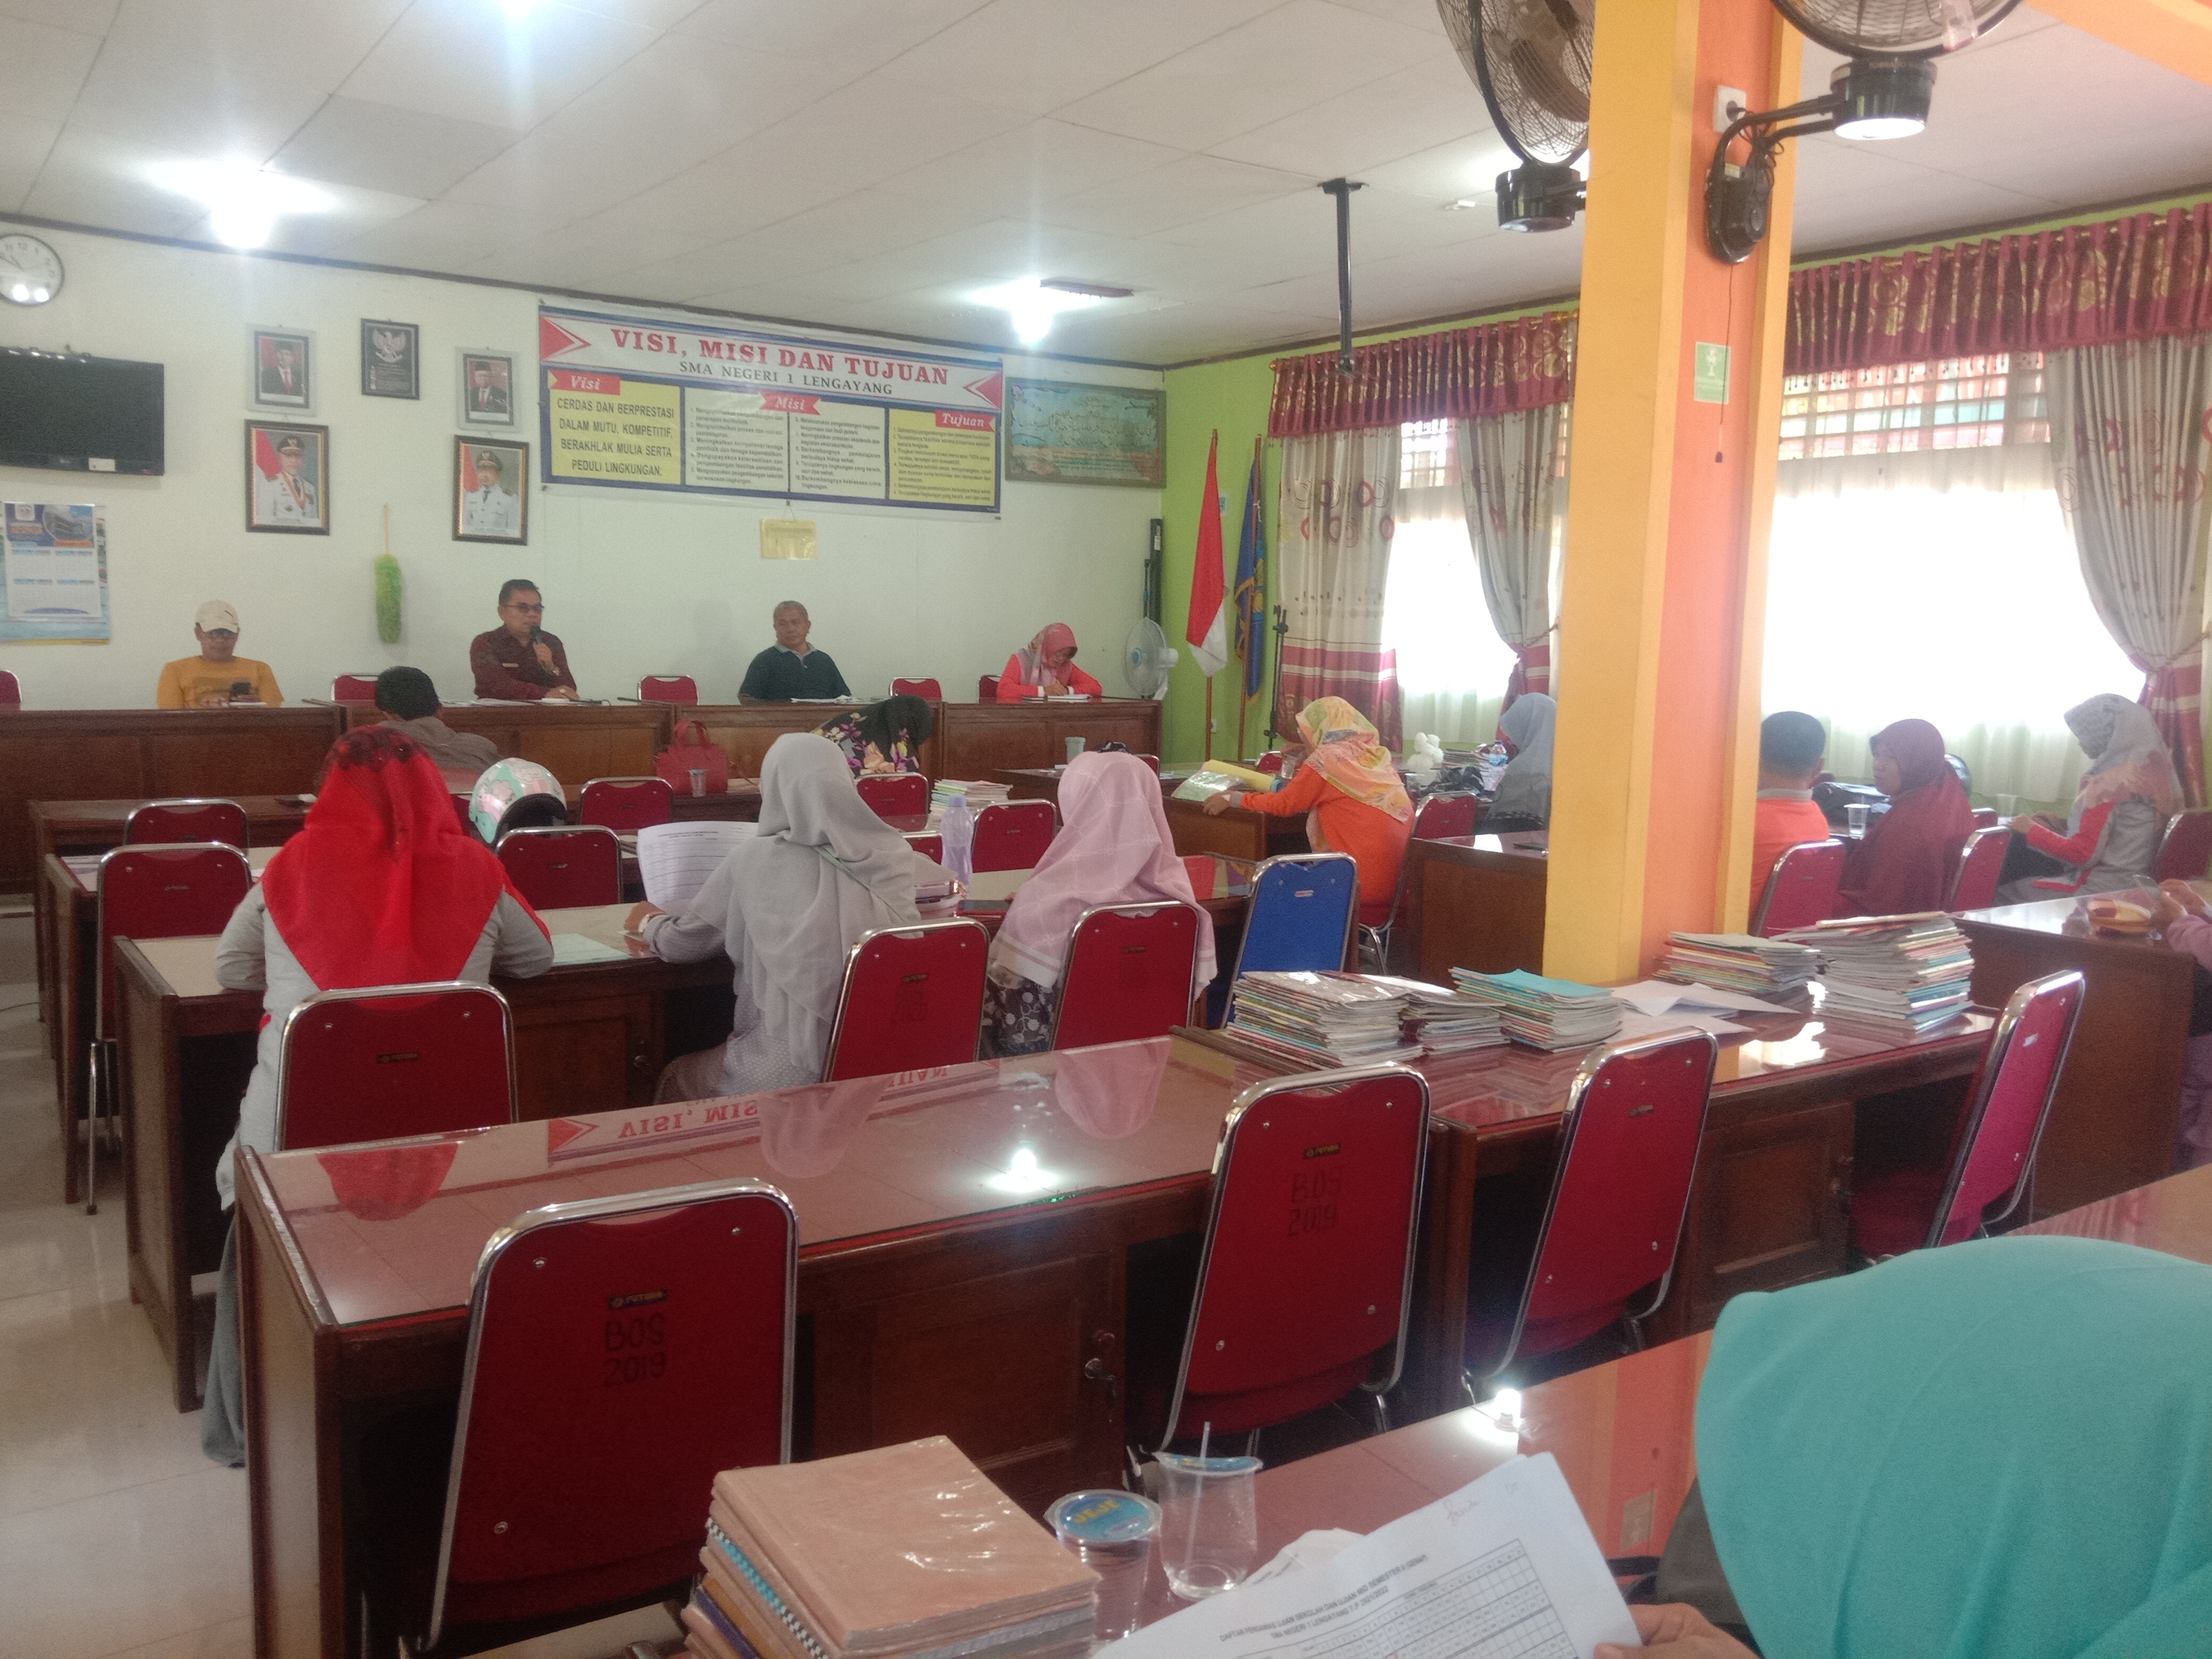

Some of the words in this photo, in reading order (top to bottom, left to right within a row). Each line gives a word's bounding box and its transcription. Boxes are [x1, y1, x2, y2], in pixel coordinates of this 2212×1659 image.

[610, 329, 686, 357] VISI,
[698, 339, 767, 364] MISI
[778, 348, 834, 372] DAN
[844, 357, 948, 385] TUJUAN
[571, 375, 601, 390] Visi
[680, 361, 713, 375] SMA
[722, 365, 778, 382] NEGERI
[787, 374, 793, 383] 1
[803, 375, 892, 395] LENGAYANG
[557, 398, 592, 411] CERDAS
[596, 401, 614, 413] DAN
[617, 403, 674, 418] BERPRESTASI
[775, 397, 805, 410] Misi
[559, 418, 589, 431] DALAM
[942, 413, 984, 427] Tujuan
[561, 439, 613, 453] BERAKHLAK
[617, 443, 642, 455] MULIA
[646, 446, 672, 457] SERTA
[572, 459, 602, 472] PEDULI
[605, 462, 662, 476] LINGKUNGAN.
[605, 1313, 665, 1351] BOS
